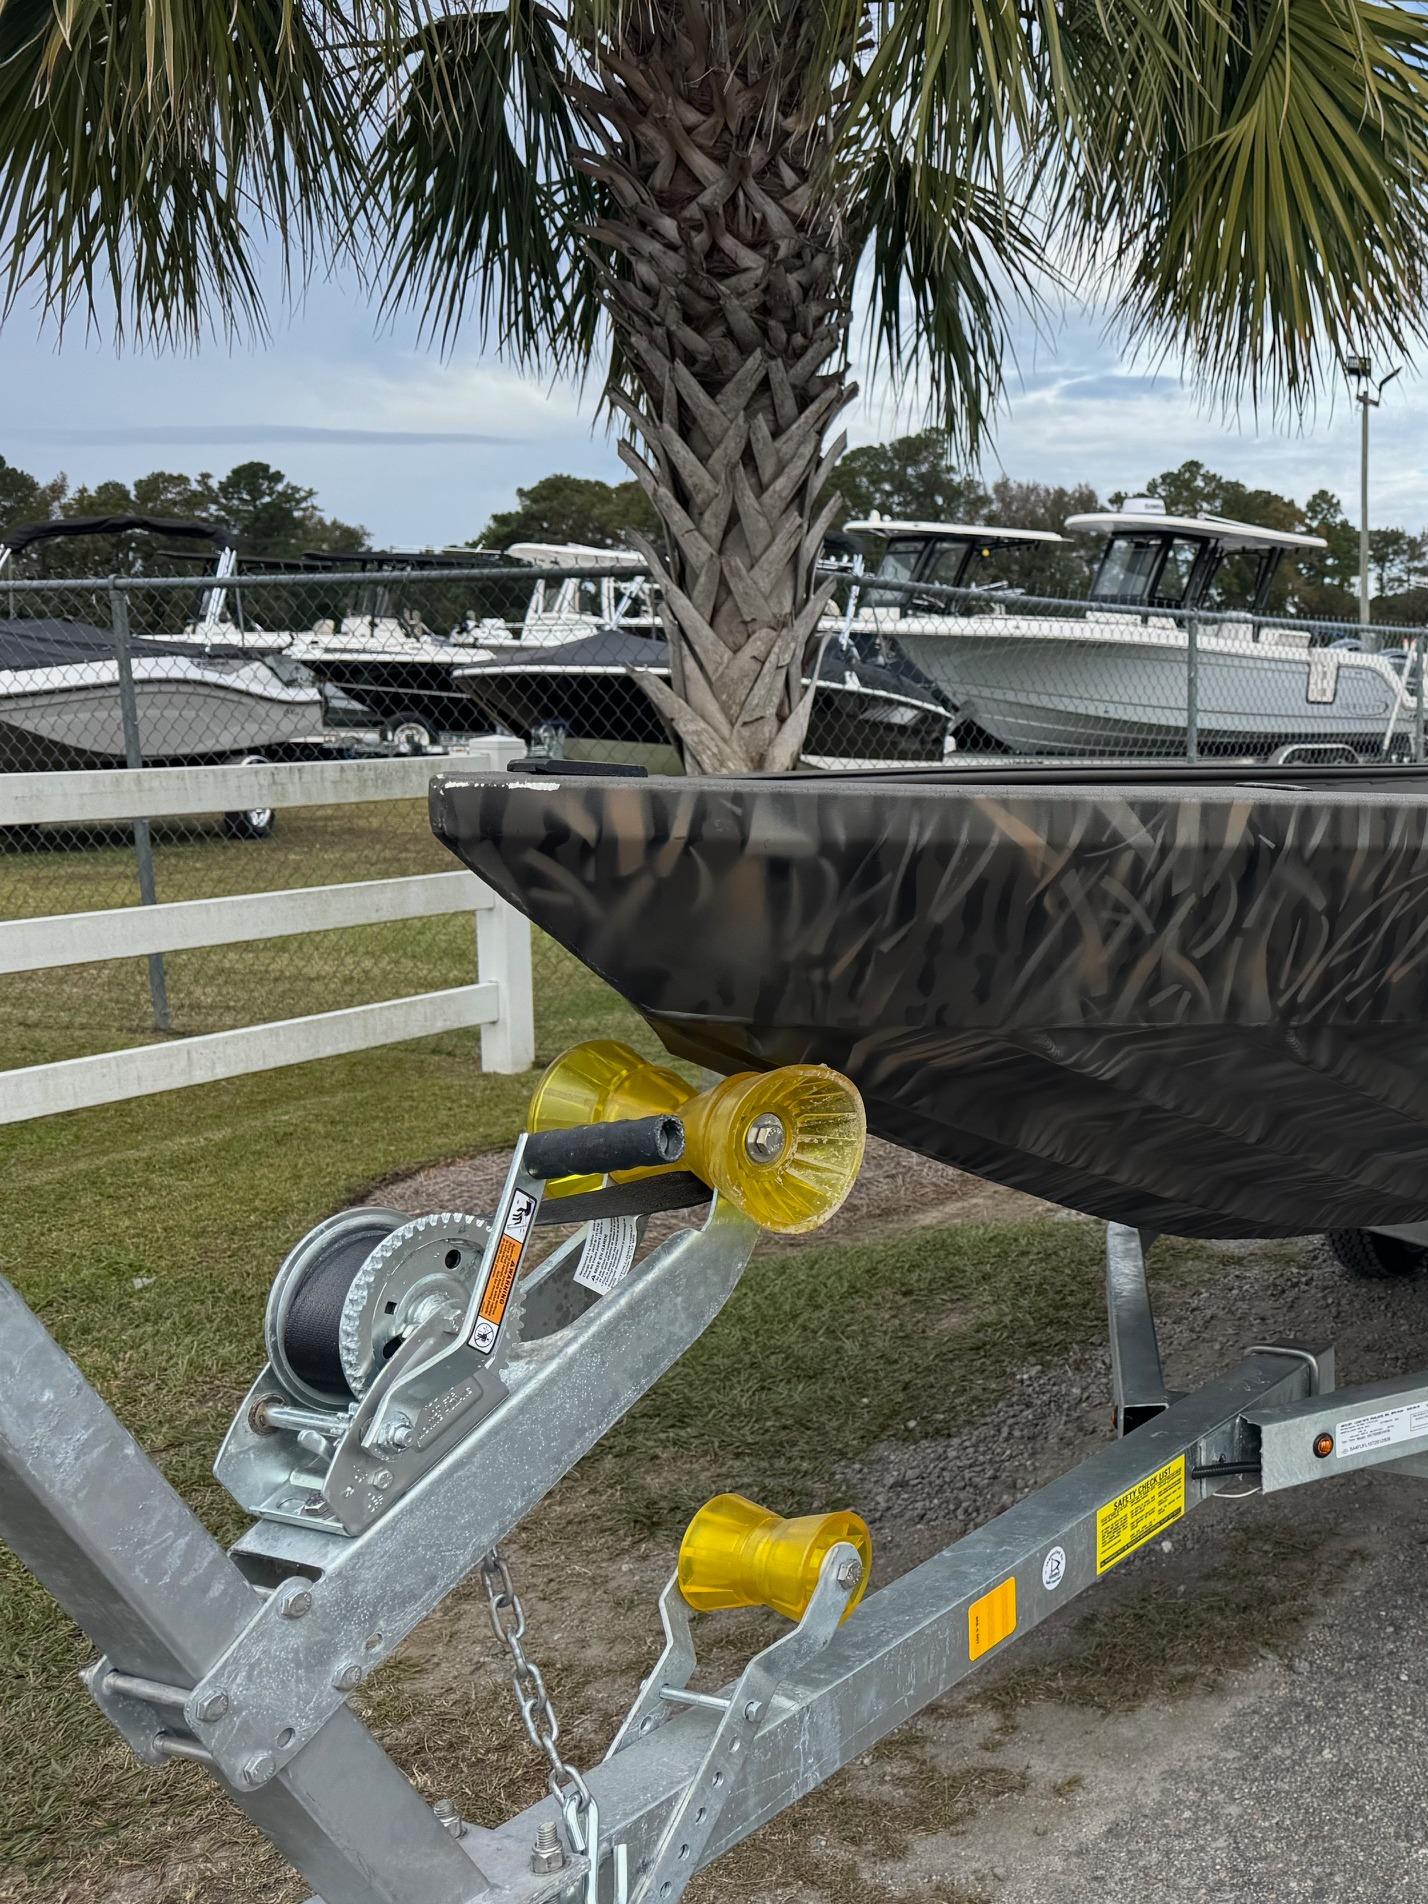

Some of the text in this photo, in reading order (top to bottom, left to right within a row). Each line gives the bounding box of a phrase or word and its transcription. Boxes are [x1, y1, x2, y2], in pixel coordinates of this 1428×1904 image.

[499, 1267, 514, 1305] WARNING
[1113, 1466, 1172, 1509] SAFETY CHECK LIST
